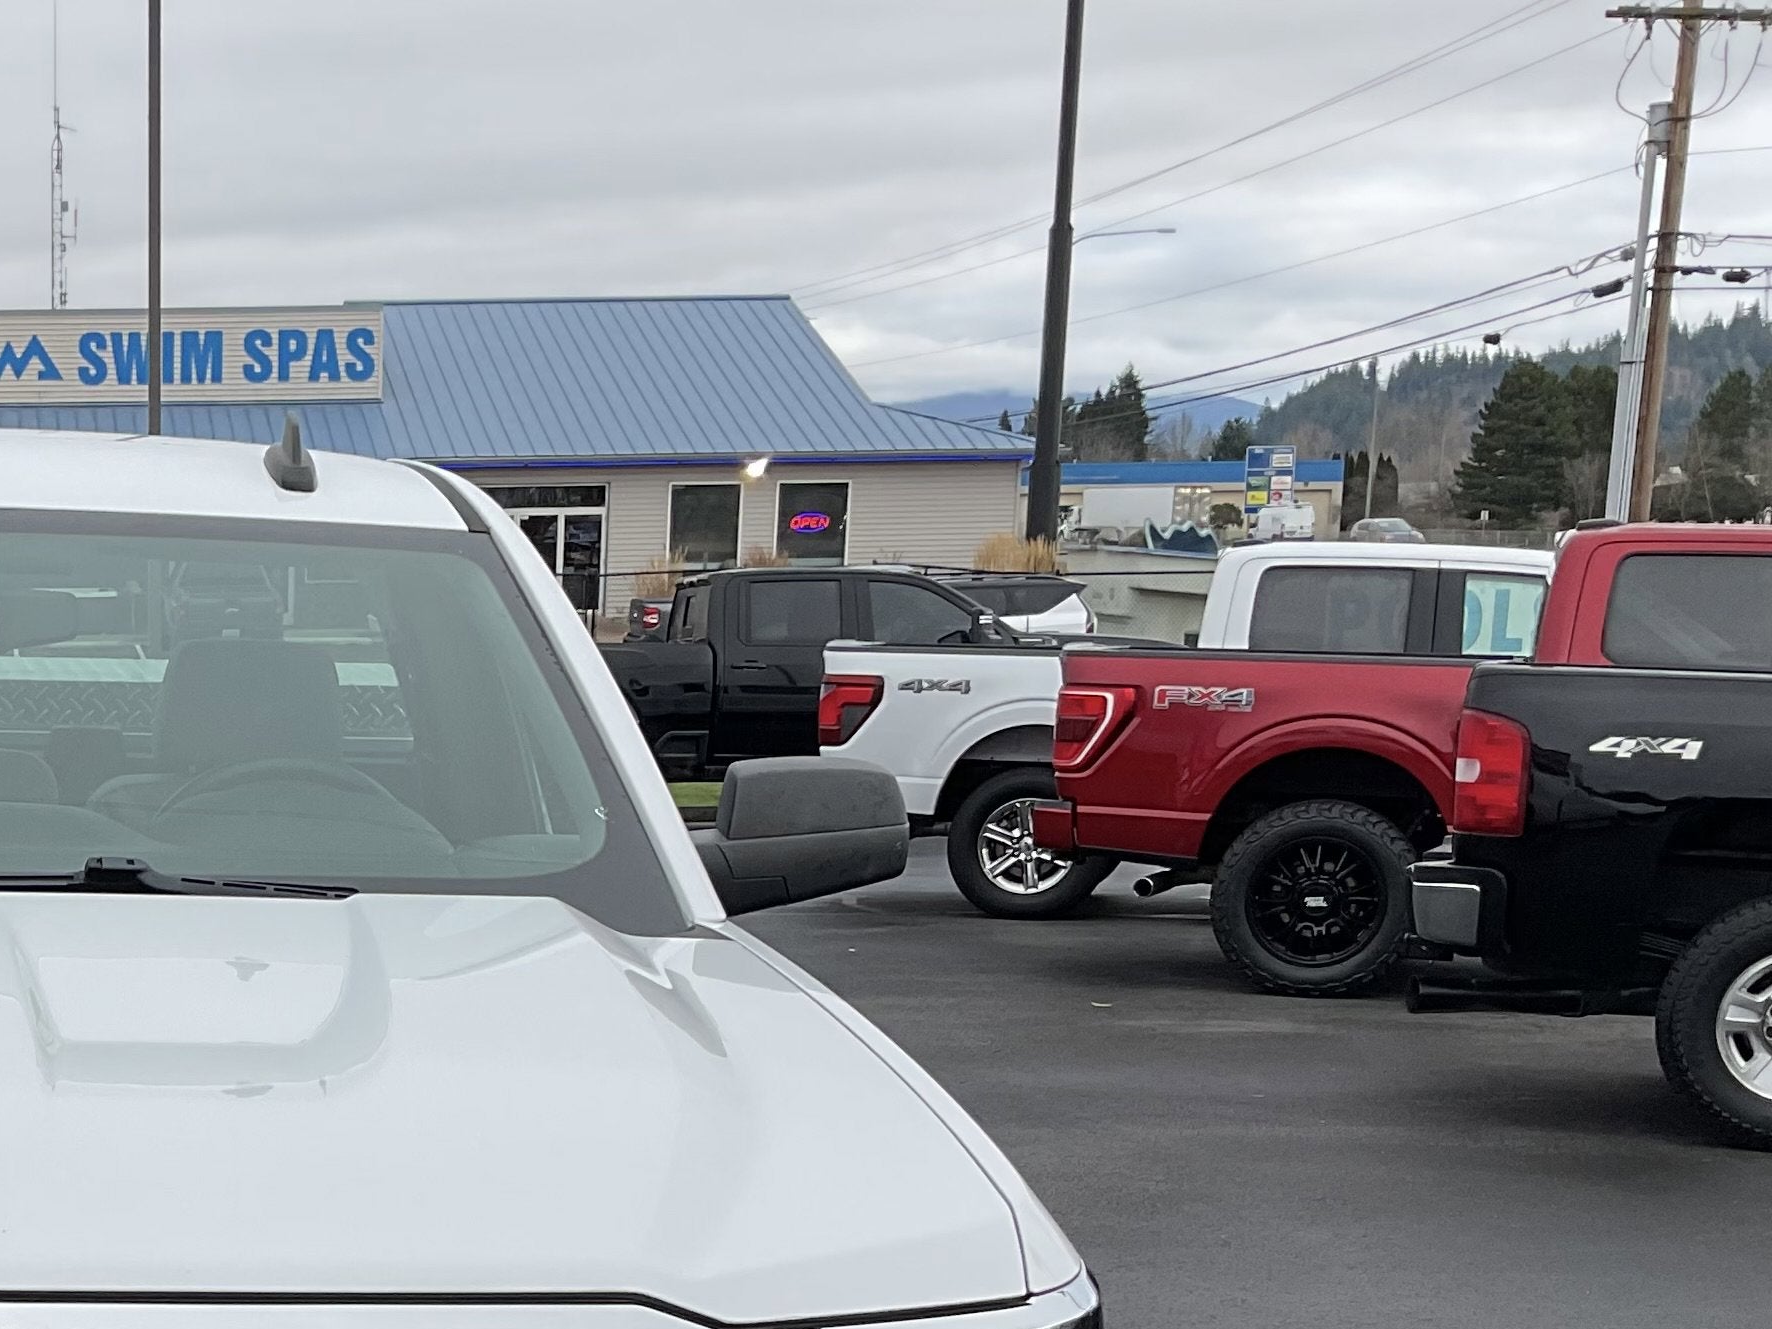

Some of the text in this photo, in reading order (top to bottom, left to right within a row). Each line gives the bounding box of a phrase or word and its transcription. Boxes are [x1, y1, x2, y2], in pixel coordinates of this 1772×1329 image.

[78, 330, 223, 386] SWIM
[242, 327, 375, 383] SPAS
[790, 516, 830, 530] OPEN
[1153, 685, 1255, 710] FX4
